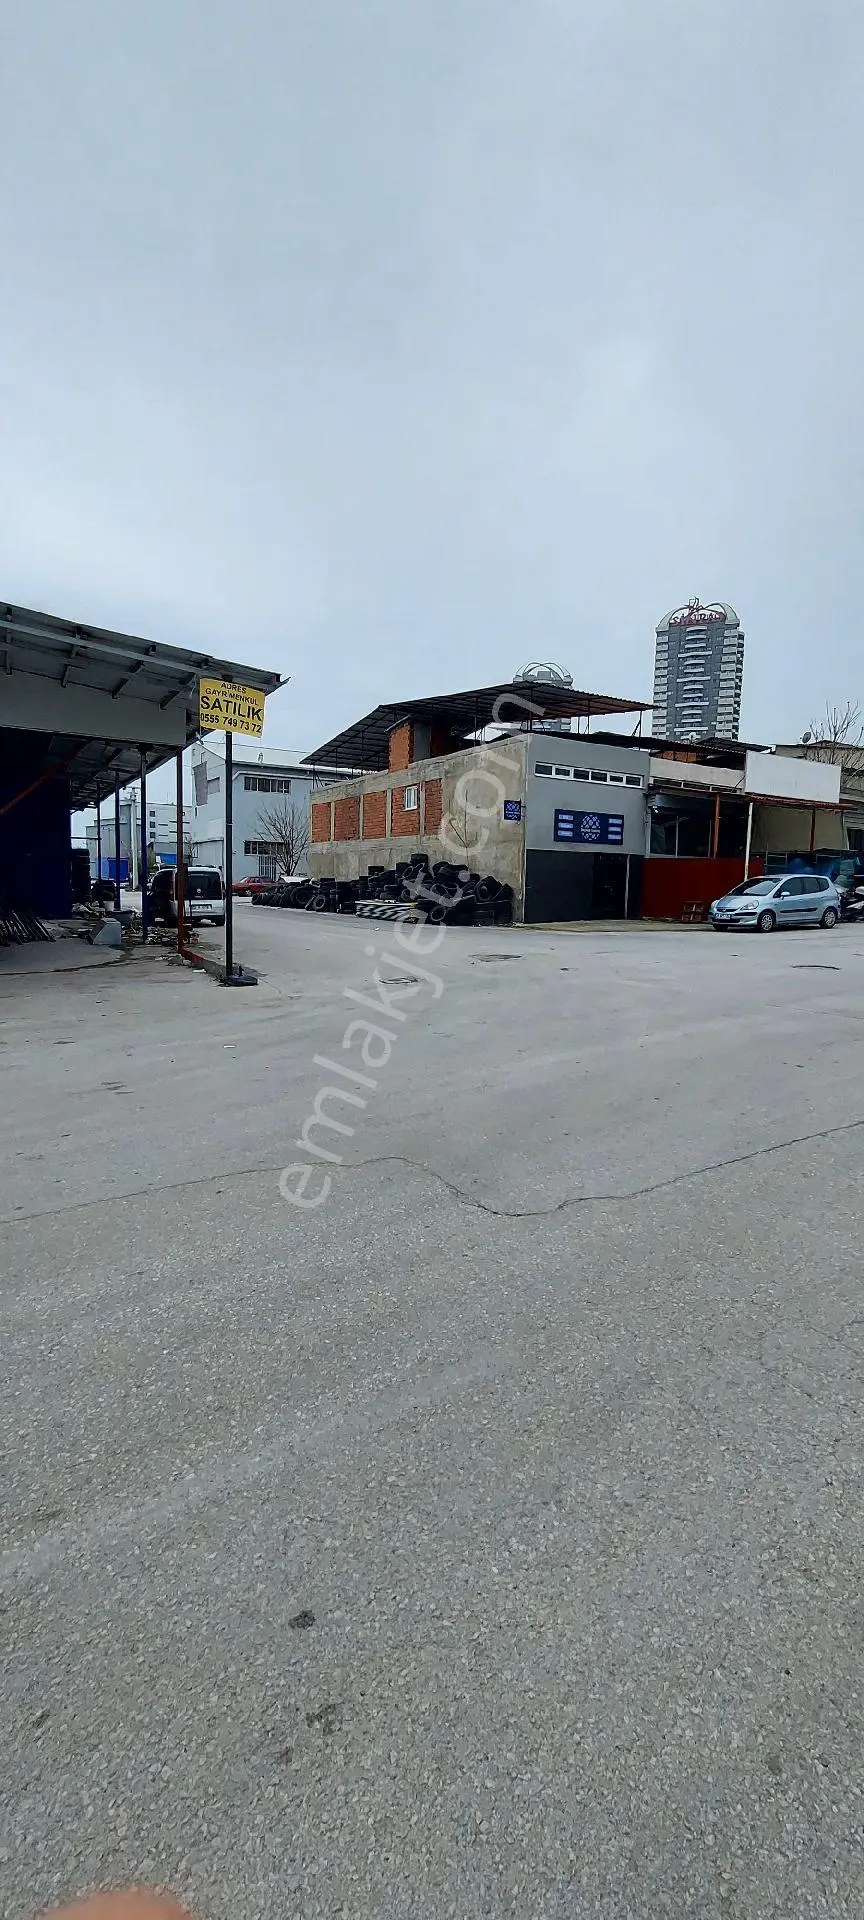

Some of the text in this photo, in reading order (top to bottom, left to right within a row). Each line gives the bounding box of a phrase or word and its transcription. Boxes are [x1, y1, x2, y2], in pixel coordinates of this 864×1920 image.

[221, 683, 247, 693] ADRES
[201, 696, 263, 721] SATILIK
[200, 713, 262, 733] 0555 749 73 72
